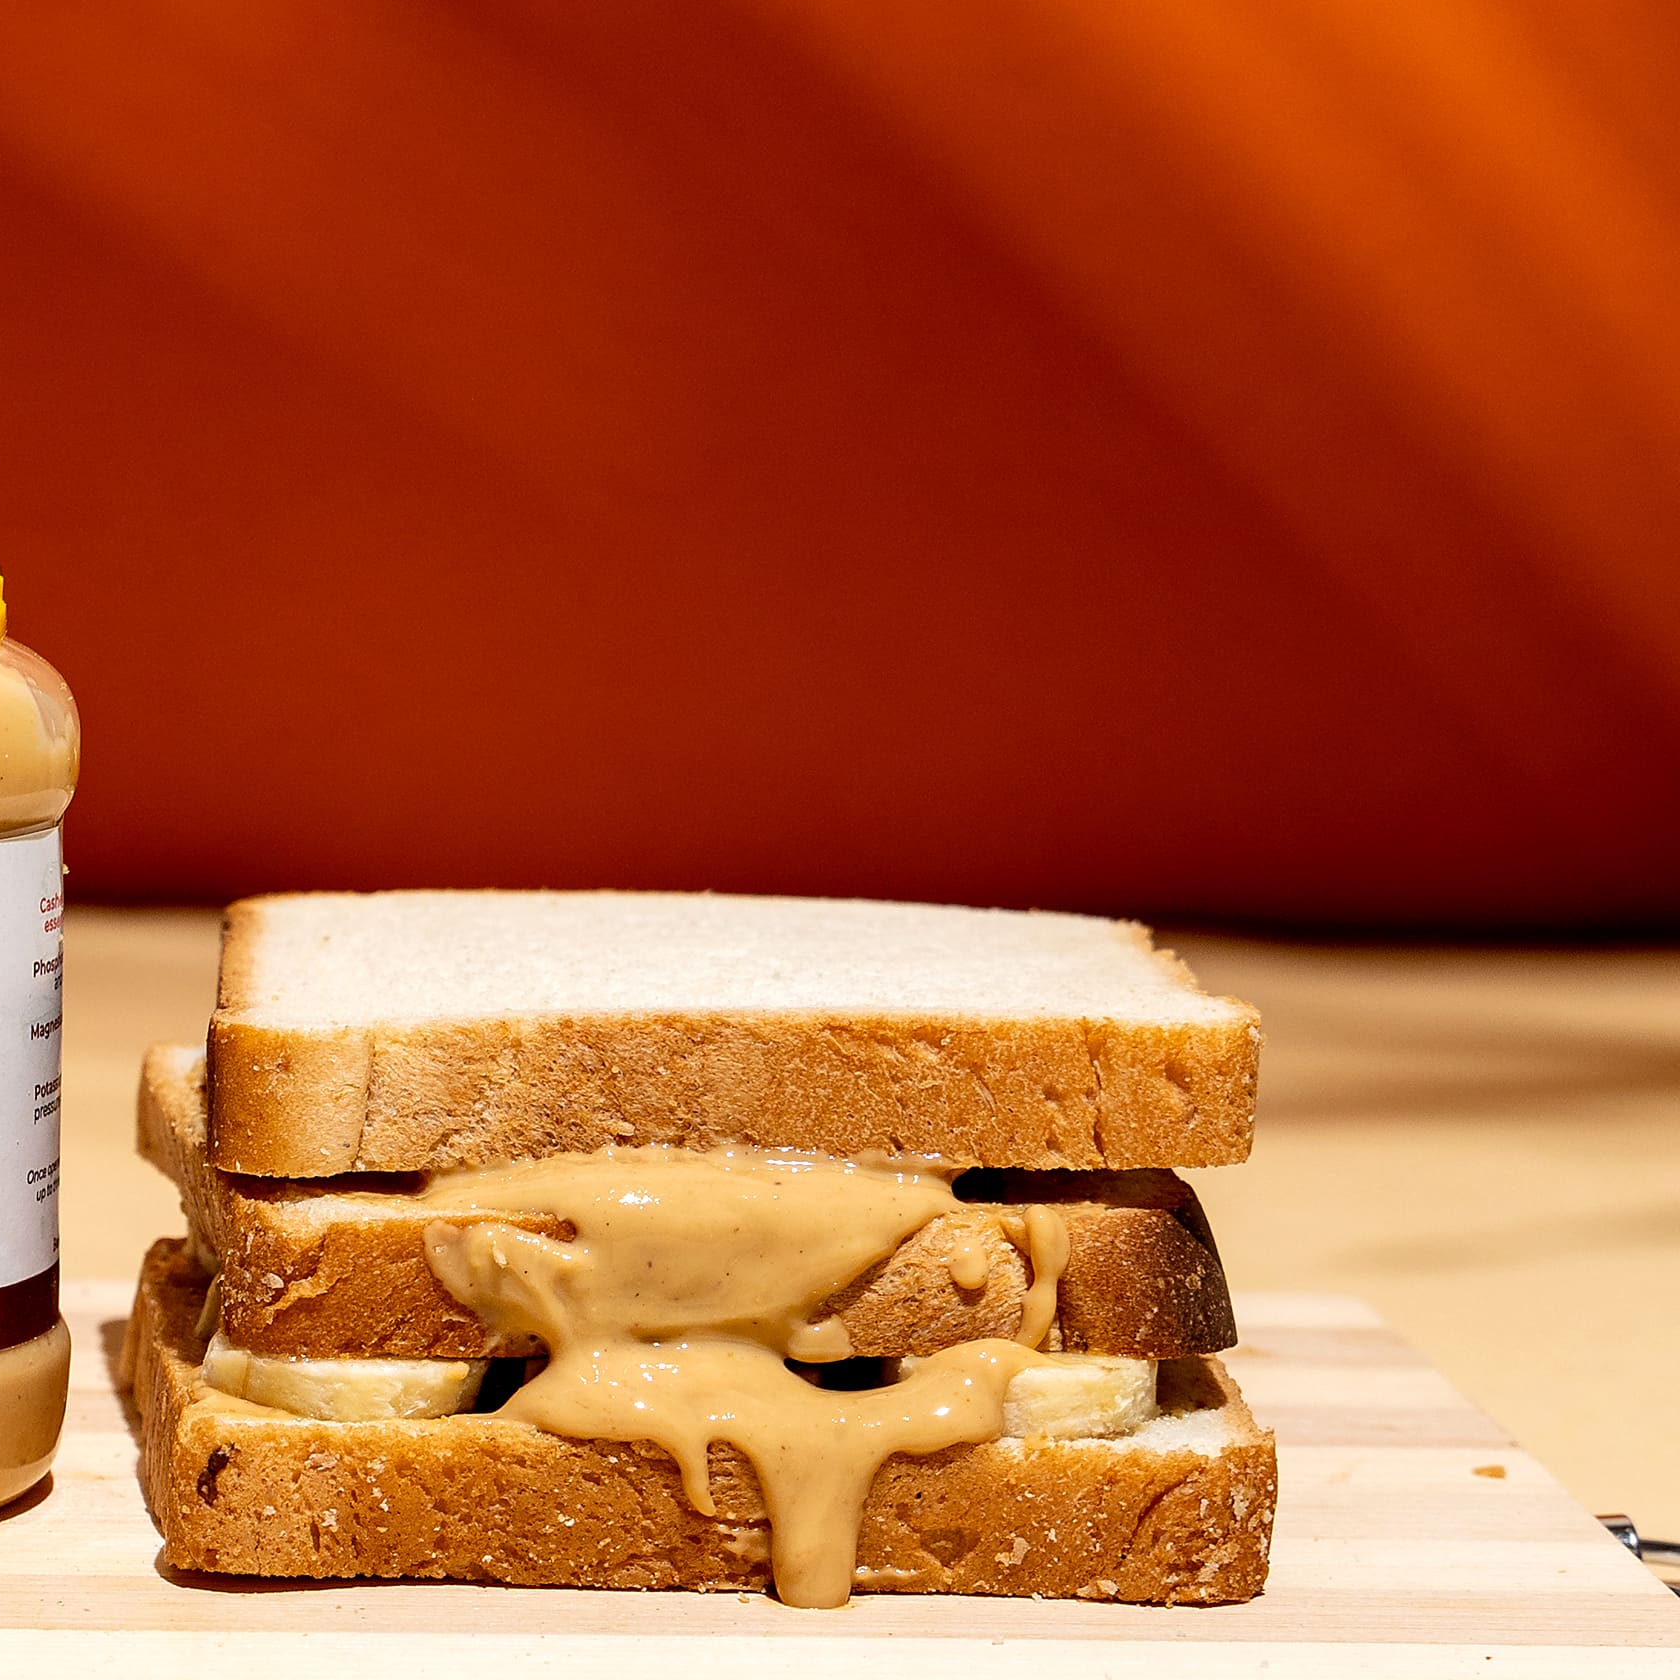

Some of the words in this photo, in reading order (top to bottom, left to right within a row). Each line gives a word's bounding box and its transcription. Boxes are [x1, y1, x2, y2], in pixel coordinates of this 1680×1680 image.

[27, 1169, 47, 1185] Once
[36, 1187, 46, 1203] up
[46, 1183, 53, 1197] to
